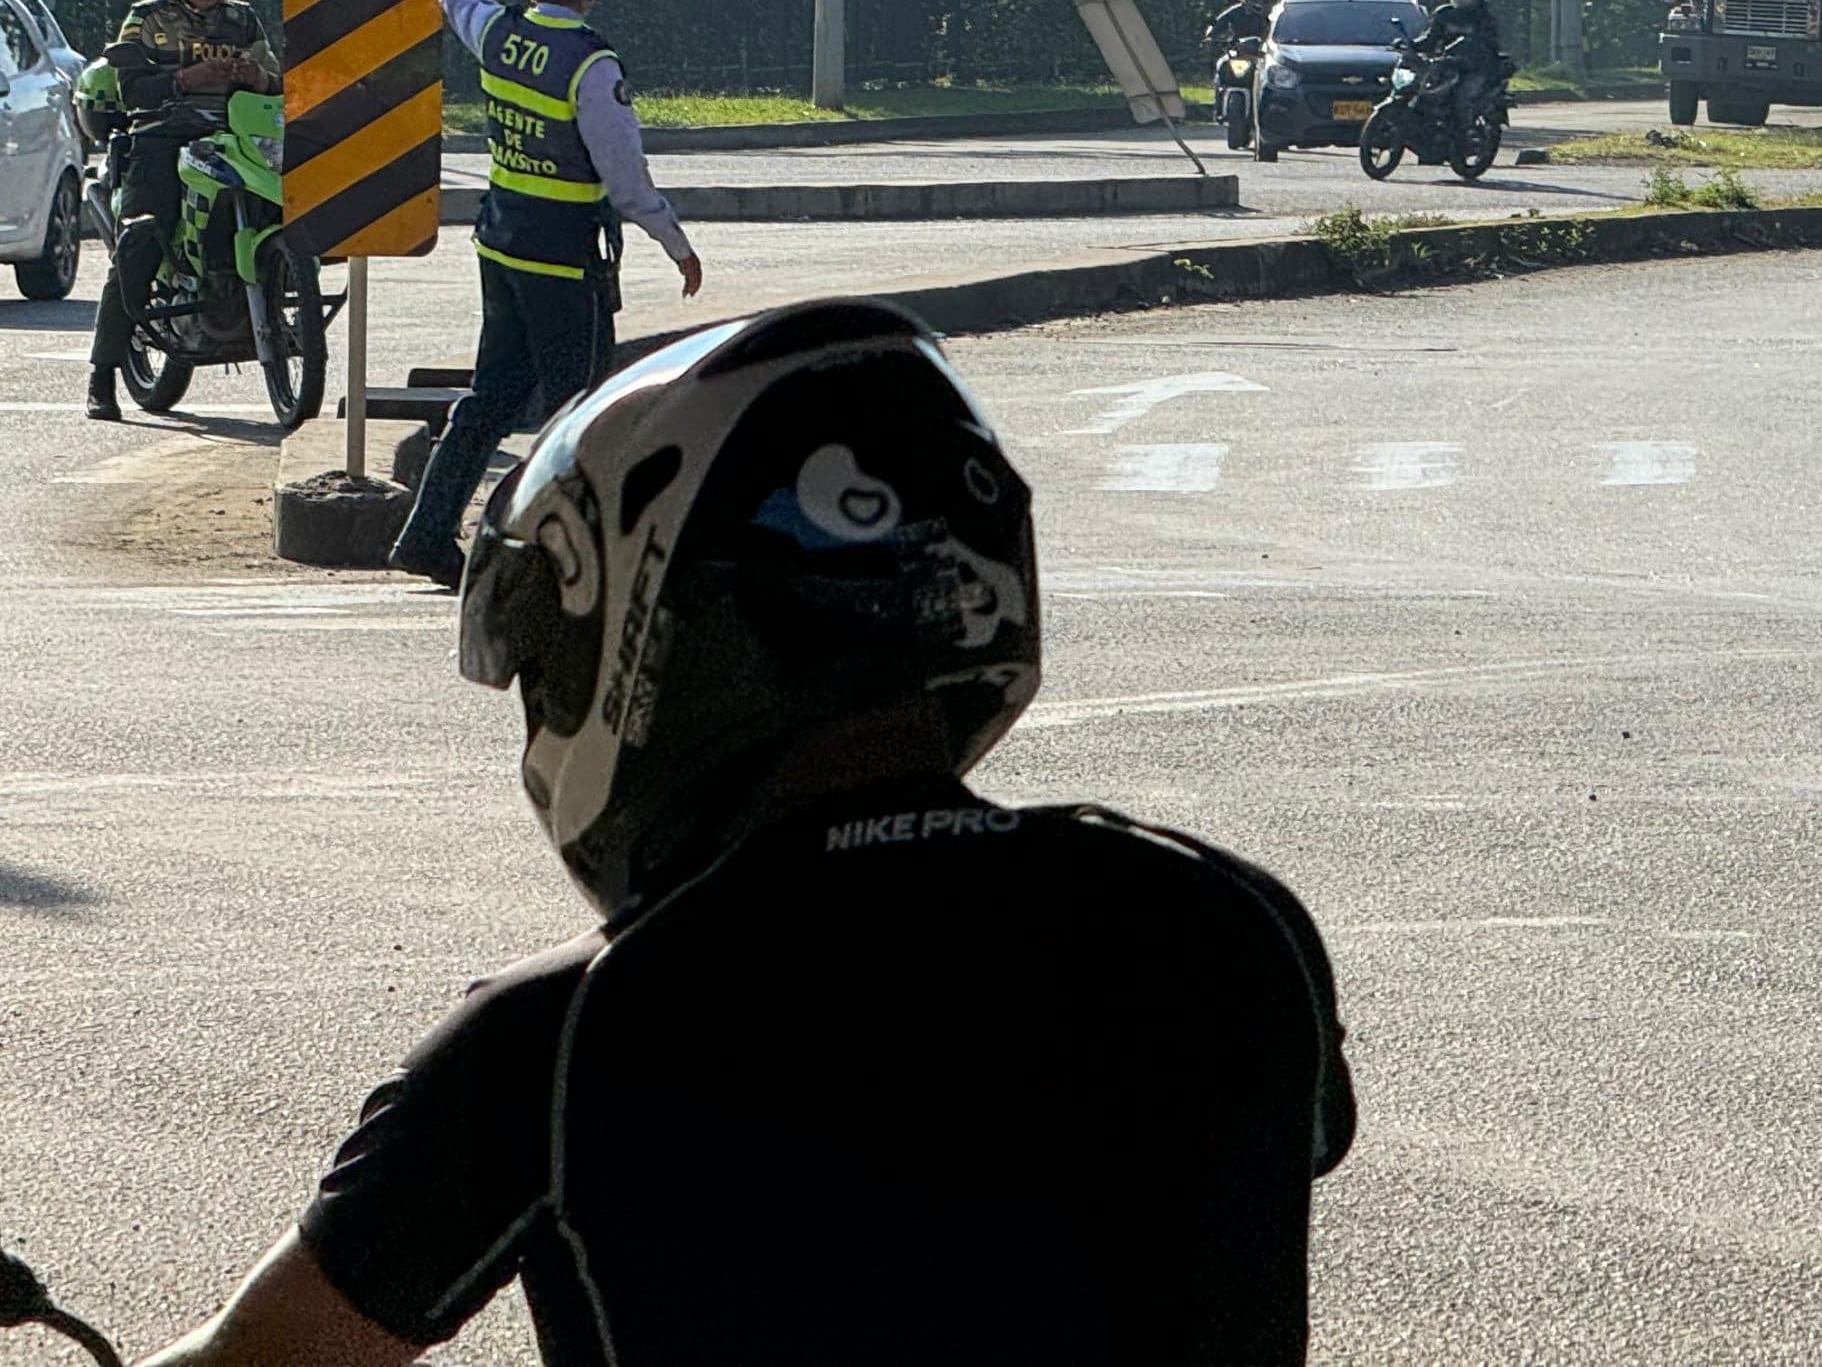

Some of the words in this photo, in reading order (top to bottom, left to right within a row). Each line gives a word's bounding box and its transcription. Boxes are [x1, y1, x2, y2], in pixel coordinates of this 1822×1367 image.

[501, 33, 549, 75] 570
[503, 129, 524, 151] DE
[825, 811, 917, 853] NIKE
[921, 807, 1021, 839] PRO
